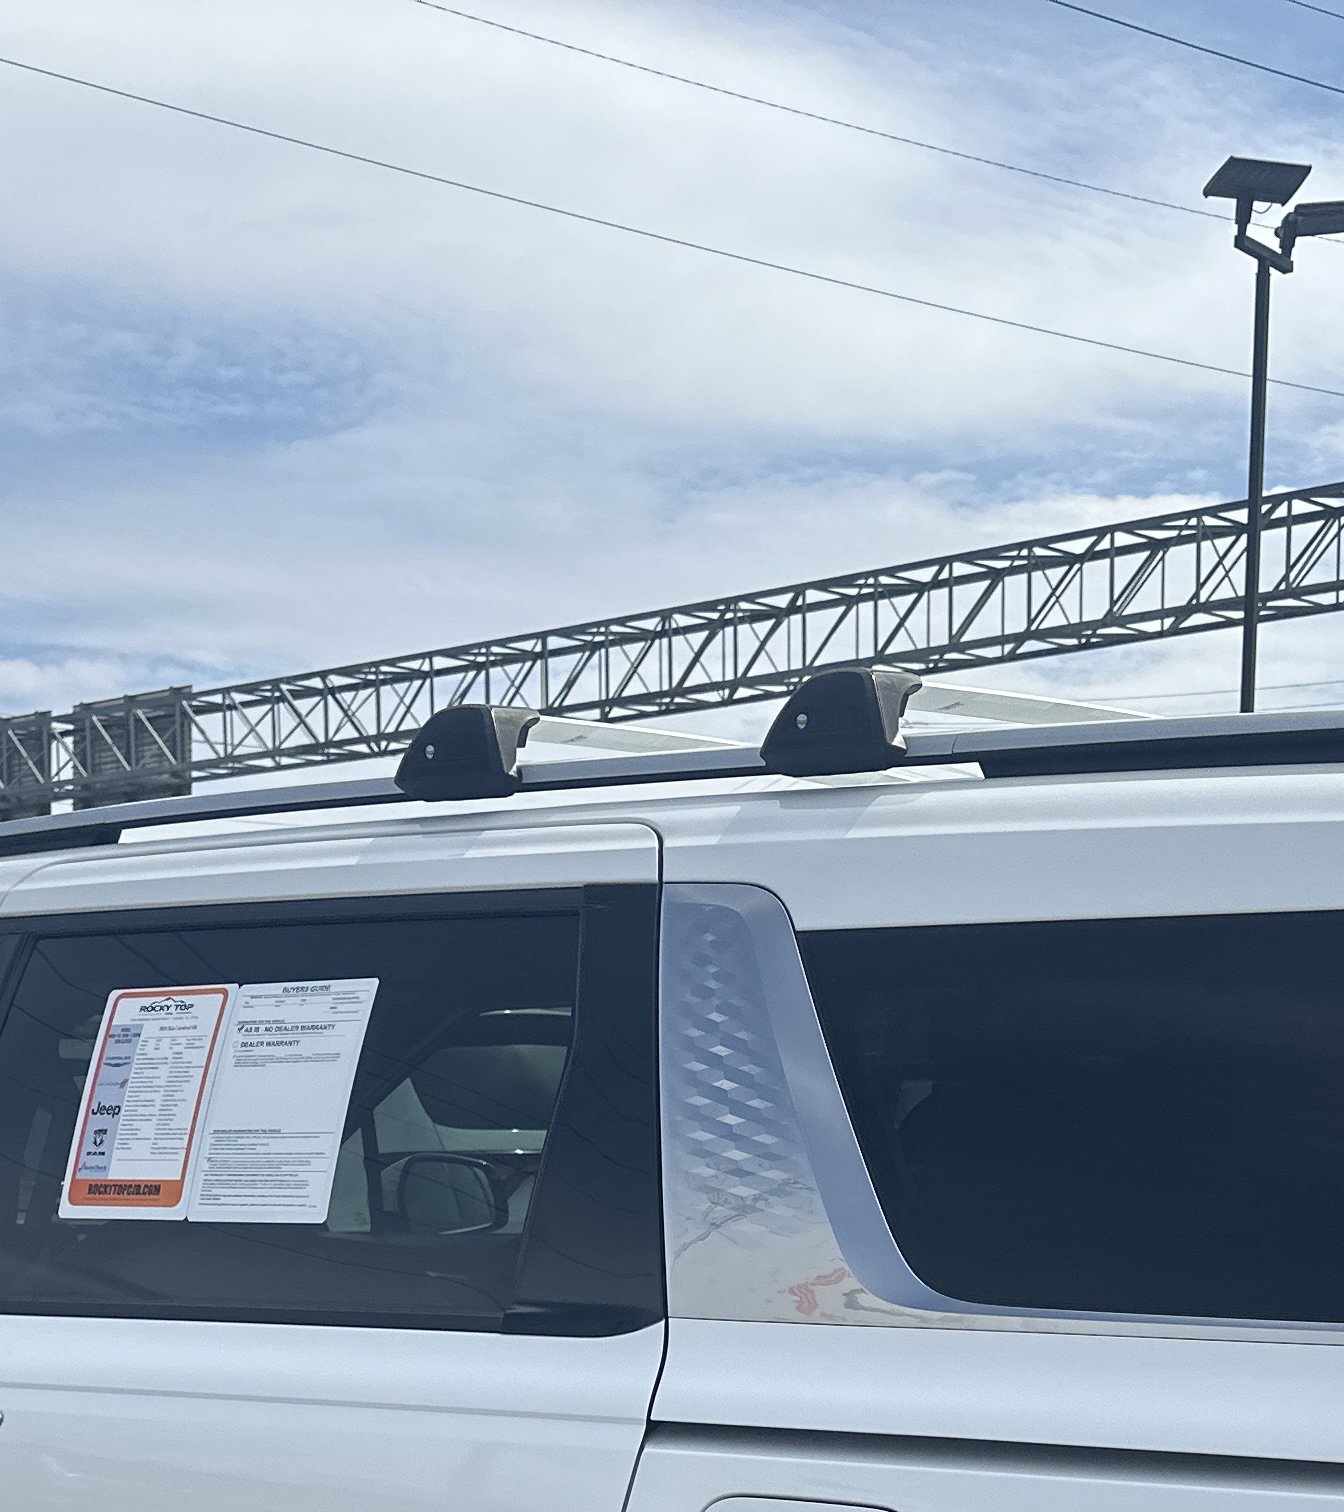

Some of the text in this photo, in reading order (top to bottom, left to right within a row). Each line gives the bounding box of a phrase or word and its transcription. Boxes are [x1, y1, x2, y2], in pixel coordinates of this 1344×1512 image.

[138, 1003, 195, 1013] ROCKY TOP
[91, 1101, 122, 1119] Jeep
